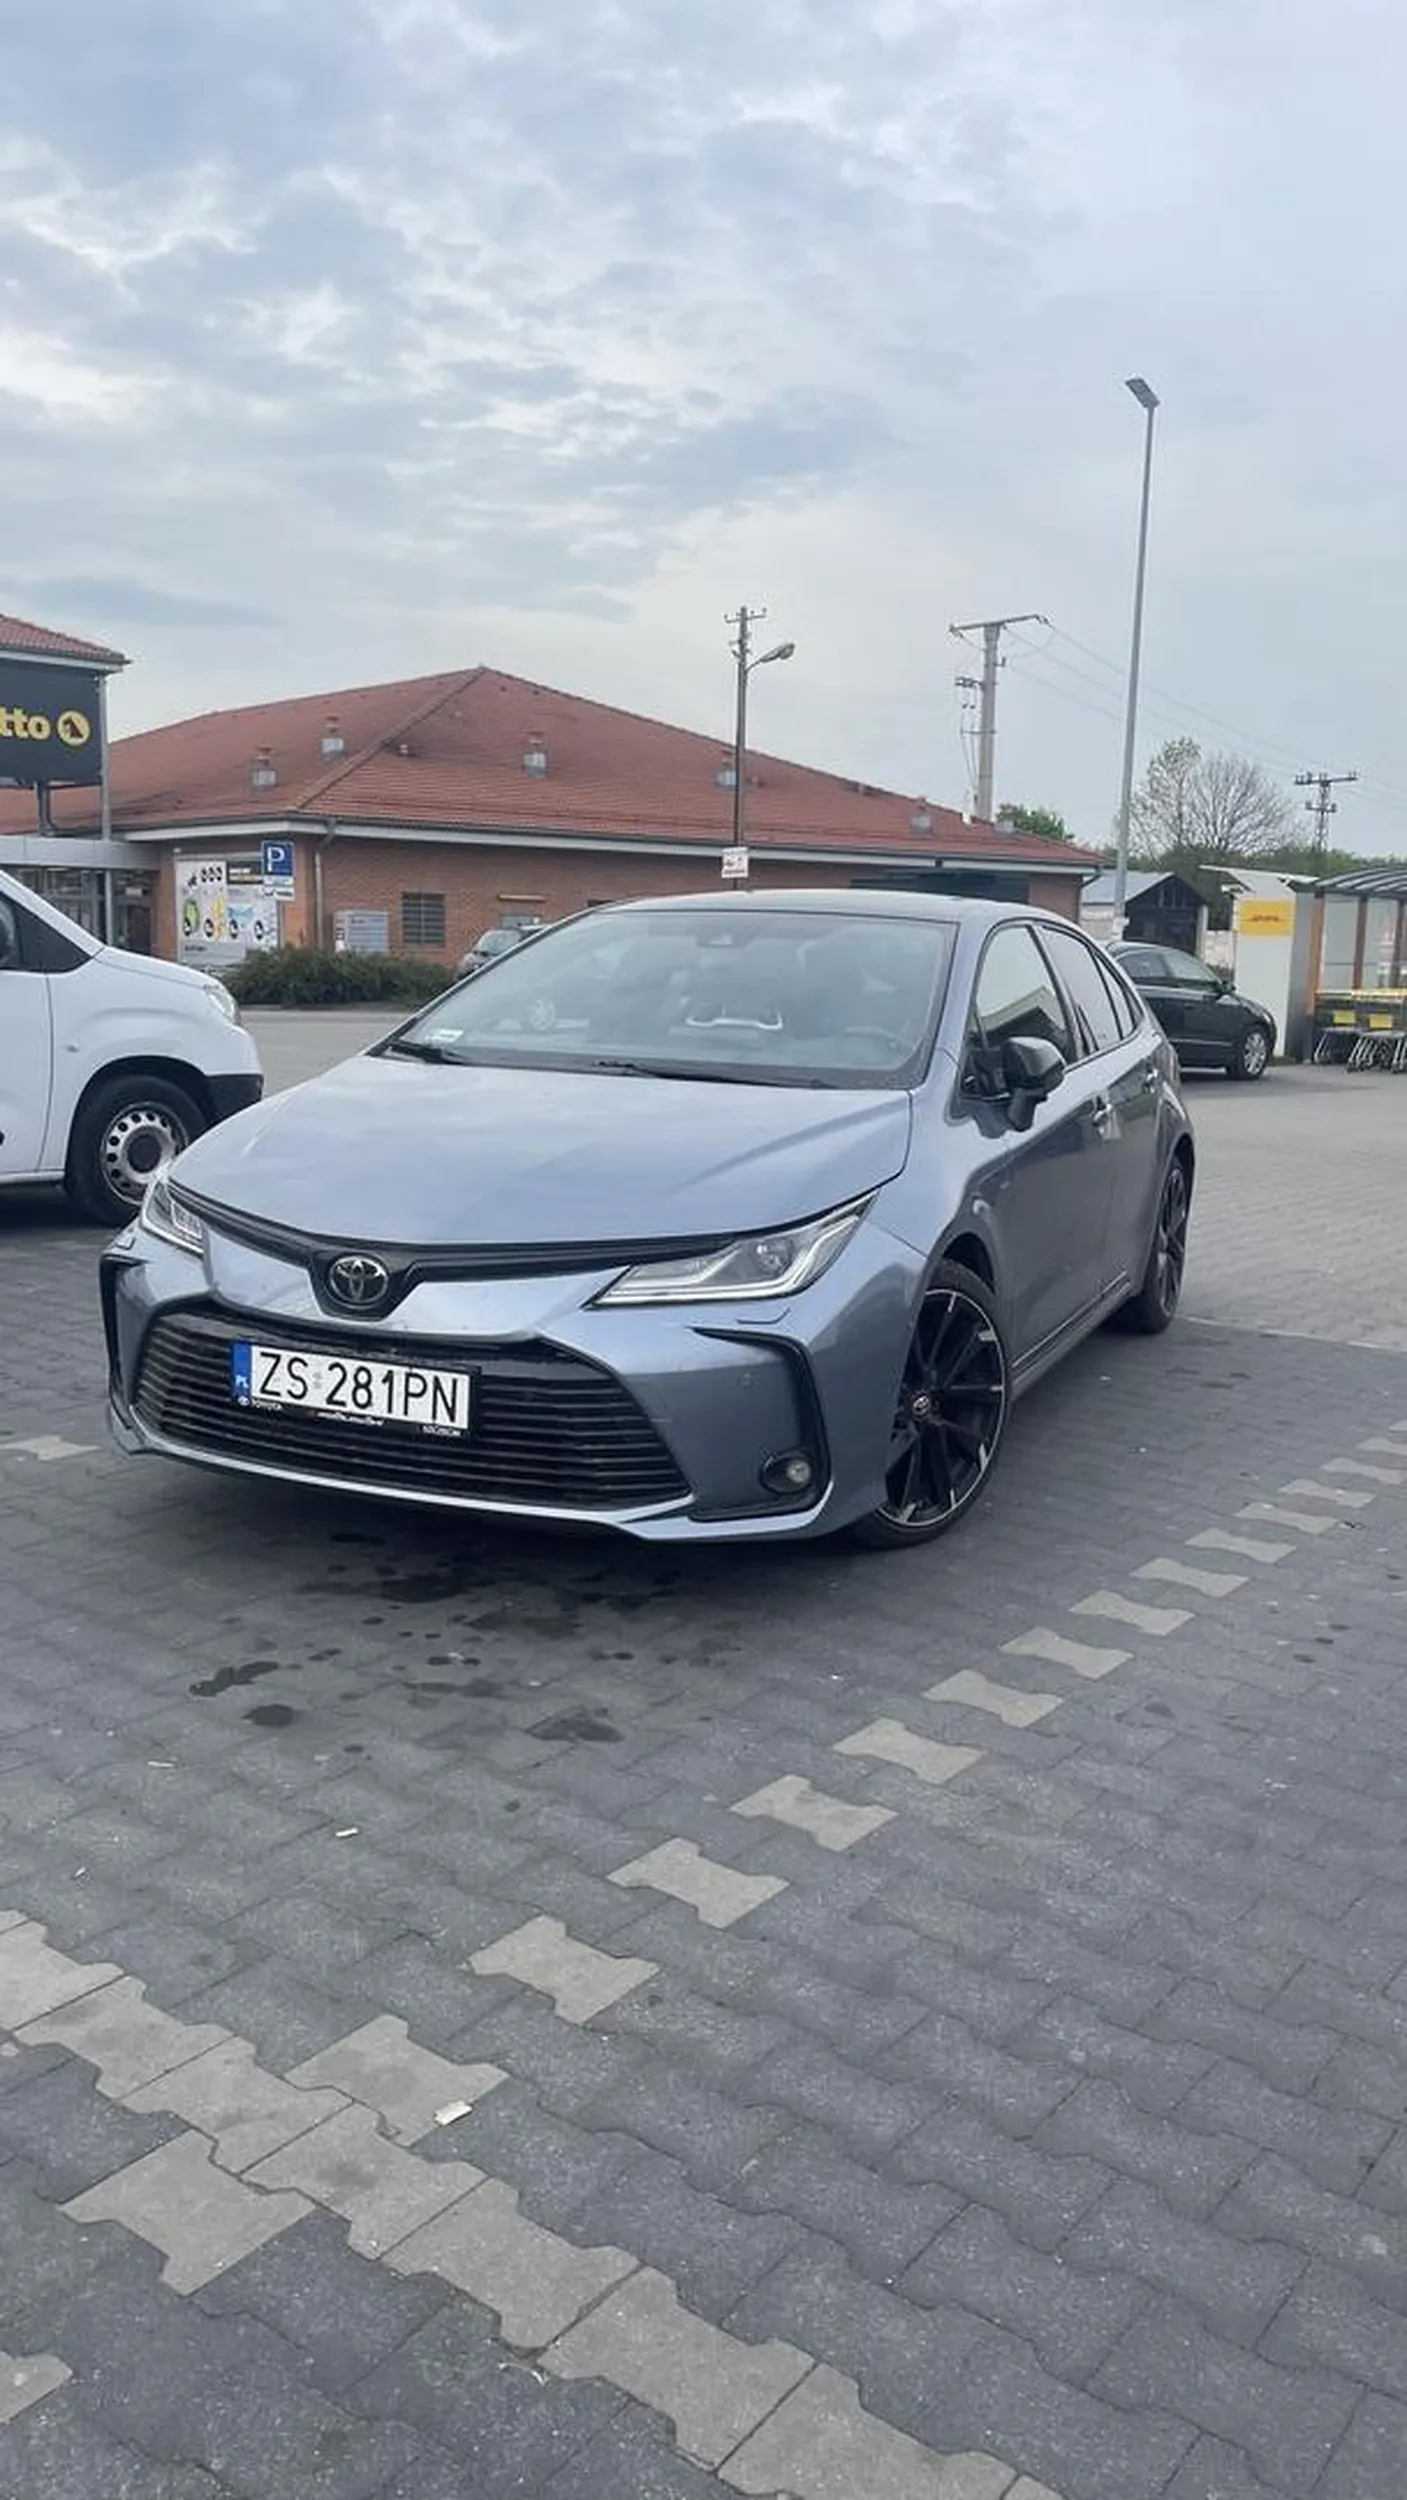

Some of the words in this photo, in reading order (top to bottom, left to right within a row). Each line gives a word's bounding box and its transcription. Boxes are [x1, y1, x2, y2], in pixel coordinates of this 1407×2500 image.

[266, 846, 285, 872] P
[260, 1352, 308, 1400] ZS
[326, 1362, 457, 1423] 281PN
